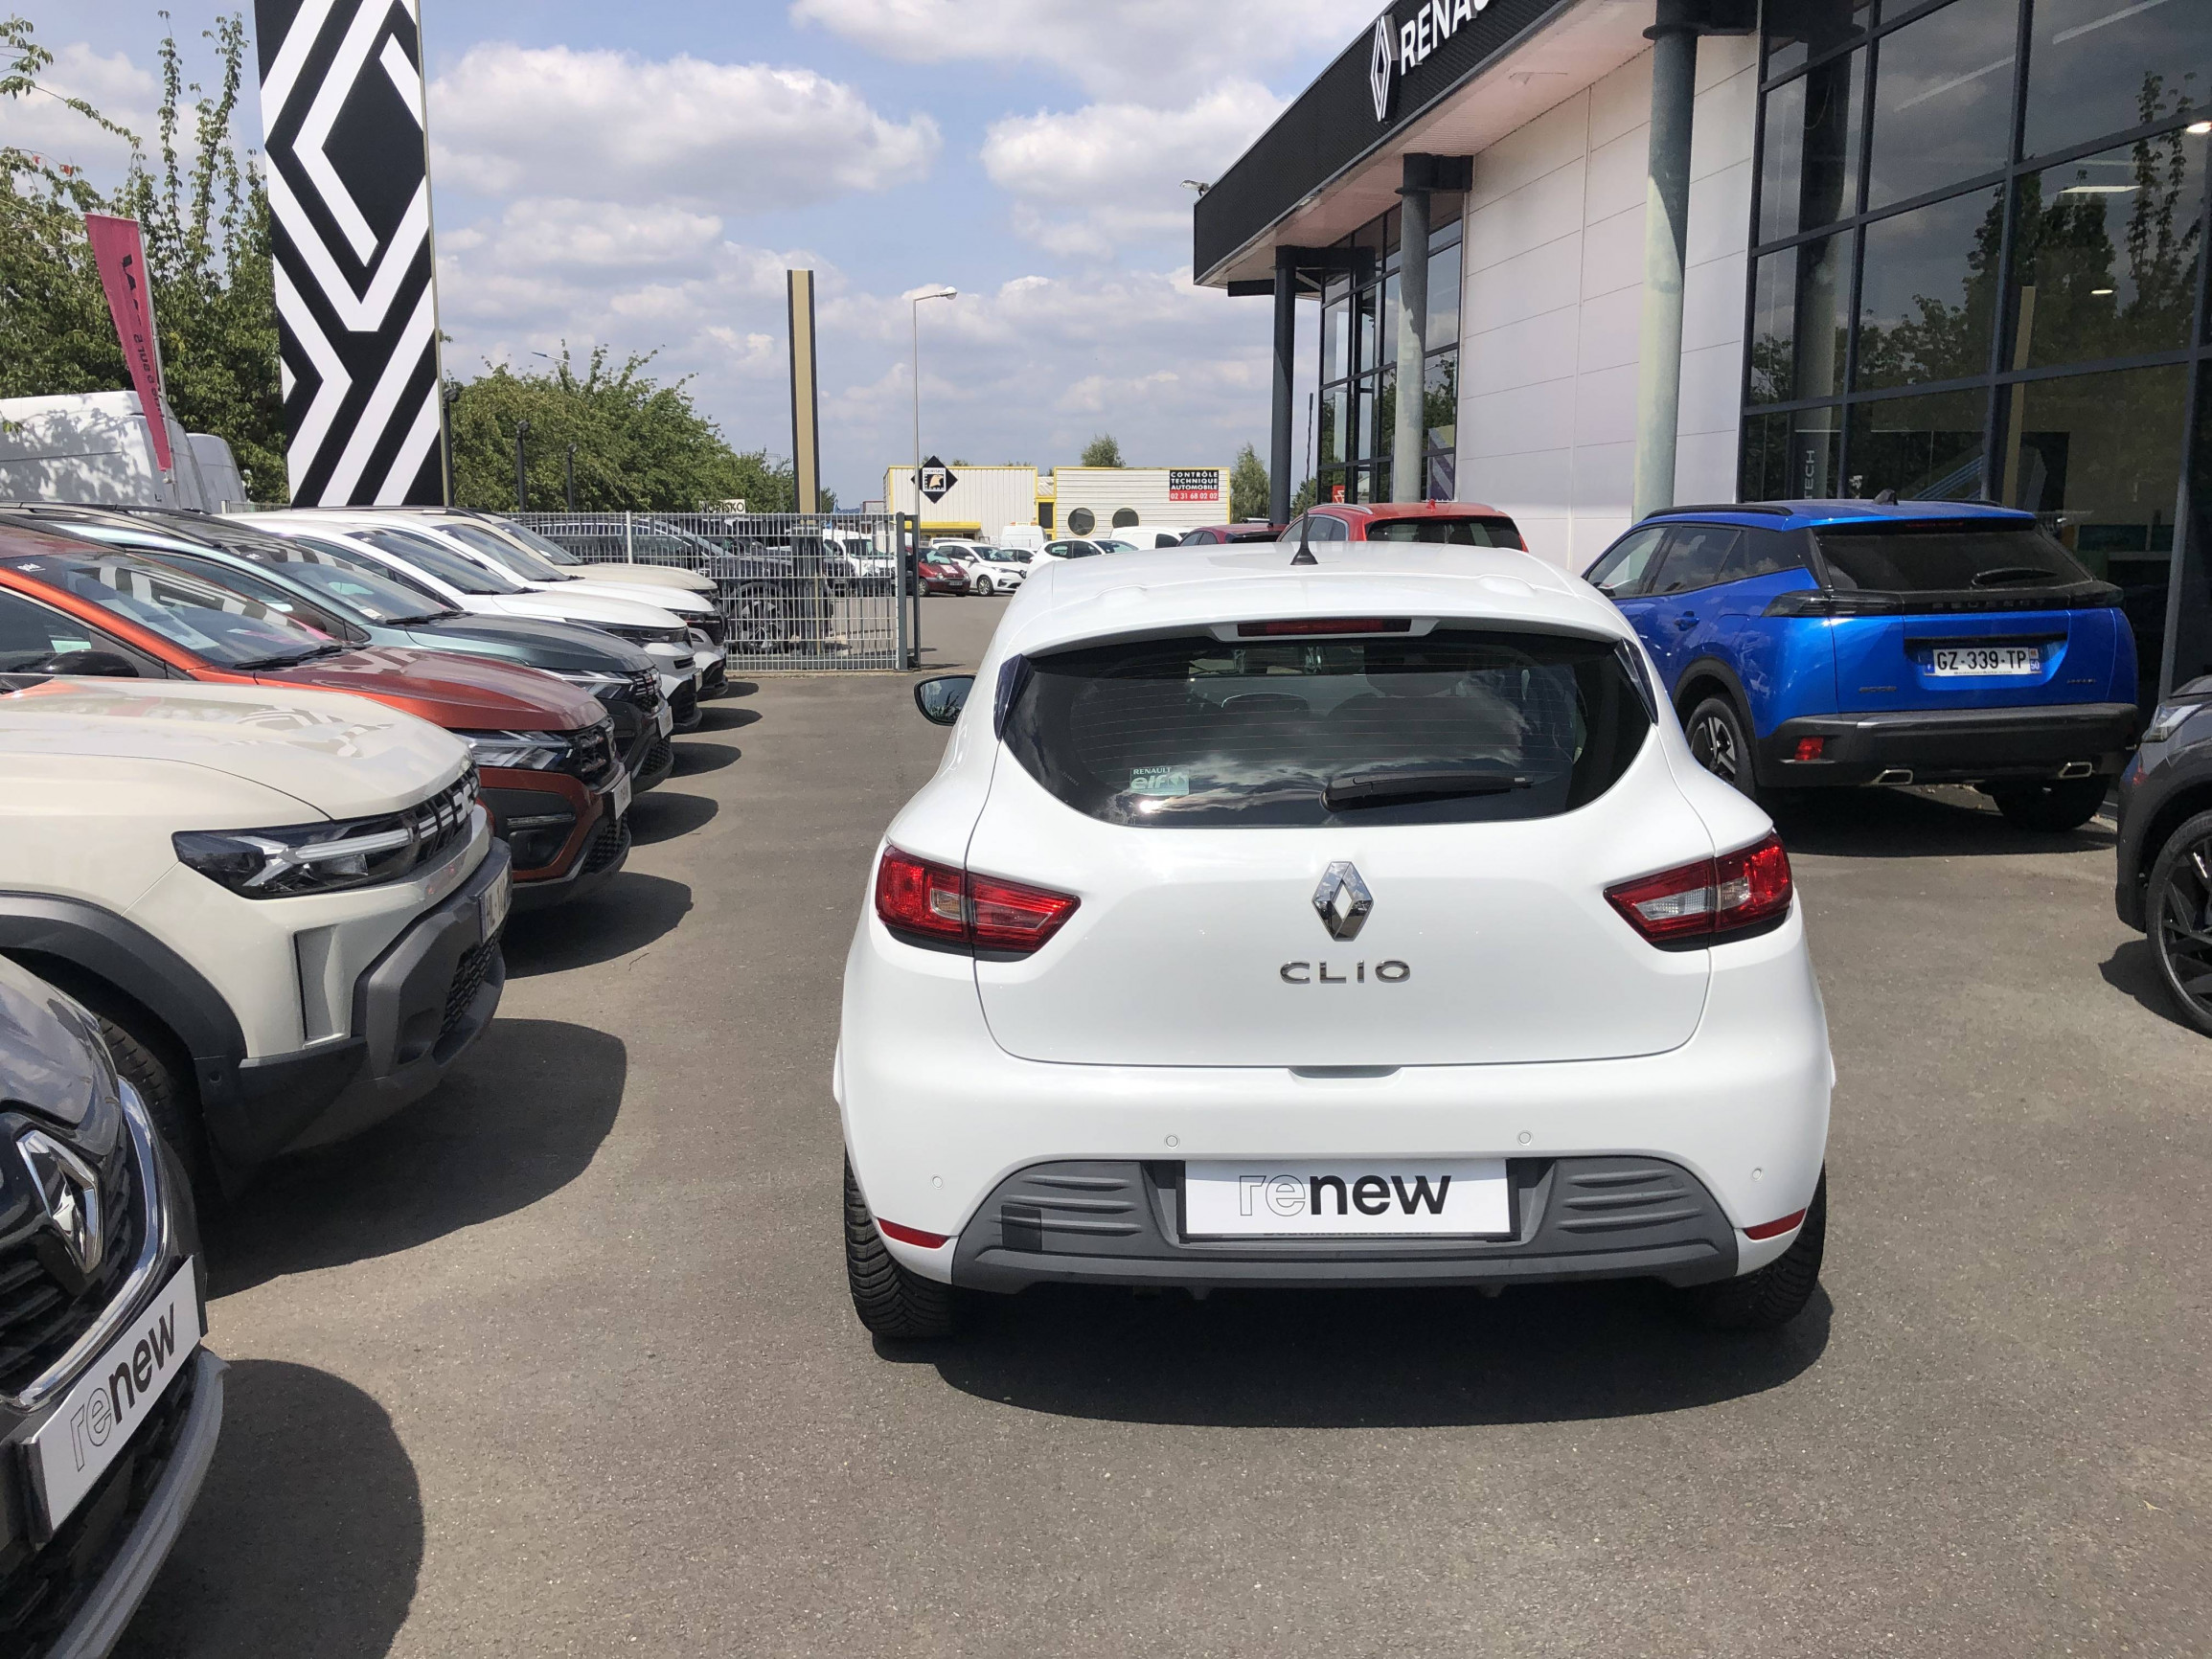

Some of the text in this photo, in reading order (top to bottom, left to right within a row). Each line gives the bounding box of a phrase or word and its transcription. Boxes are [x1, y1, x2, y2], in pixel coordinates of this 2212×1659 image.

[1401, 0, 1488, 76] RENA
[1936, 650, 2027, 670] GZ-339-TP
[2030, 660, 2041, 670] 50
[1130, 774, 1168, 790] elf
[1280, 959, 1411, 985] CLIO
[1239, 1174, 1452, 1216] renew
[69, 1301, 175, 1473] renew
